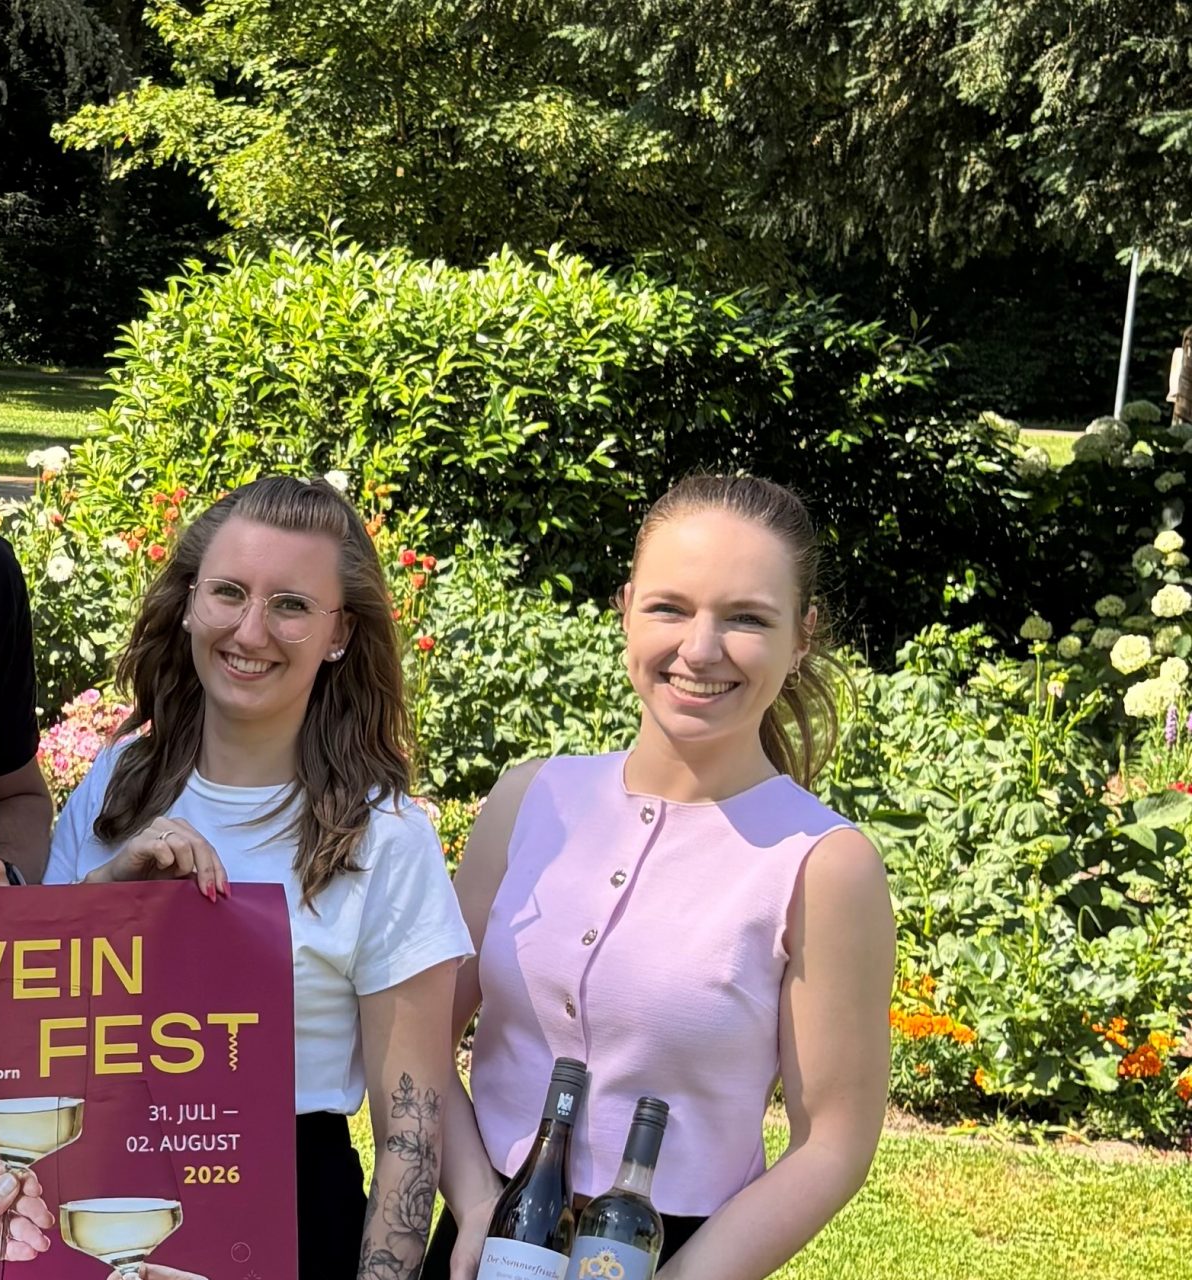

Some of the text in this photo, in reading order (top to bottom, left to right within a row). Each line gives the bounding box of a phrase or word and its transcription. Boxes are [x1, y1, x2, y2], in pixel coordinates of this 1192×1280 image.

[39, 1012, 259, 1078] FEST
[148, 1105, 173, 1121] 31.
[176, 1103, 216, 1125] JULI
[126, 1134, 241, 1152] 02. AUGUST
[183, 1165, 241, 1184] 2026
